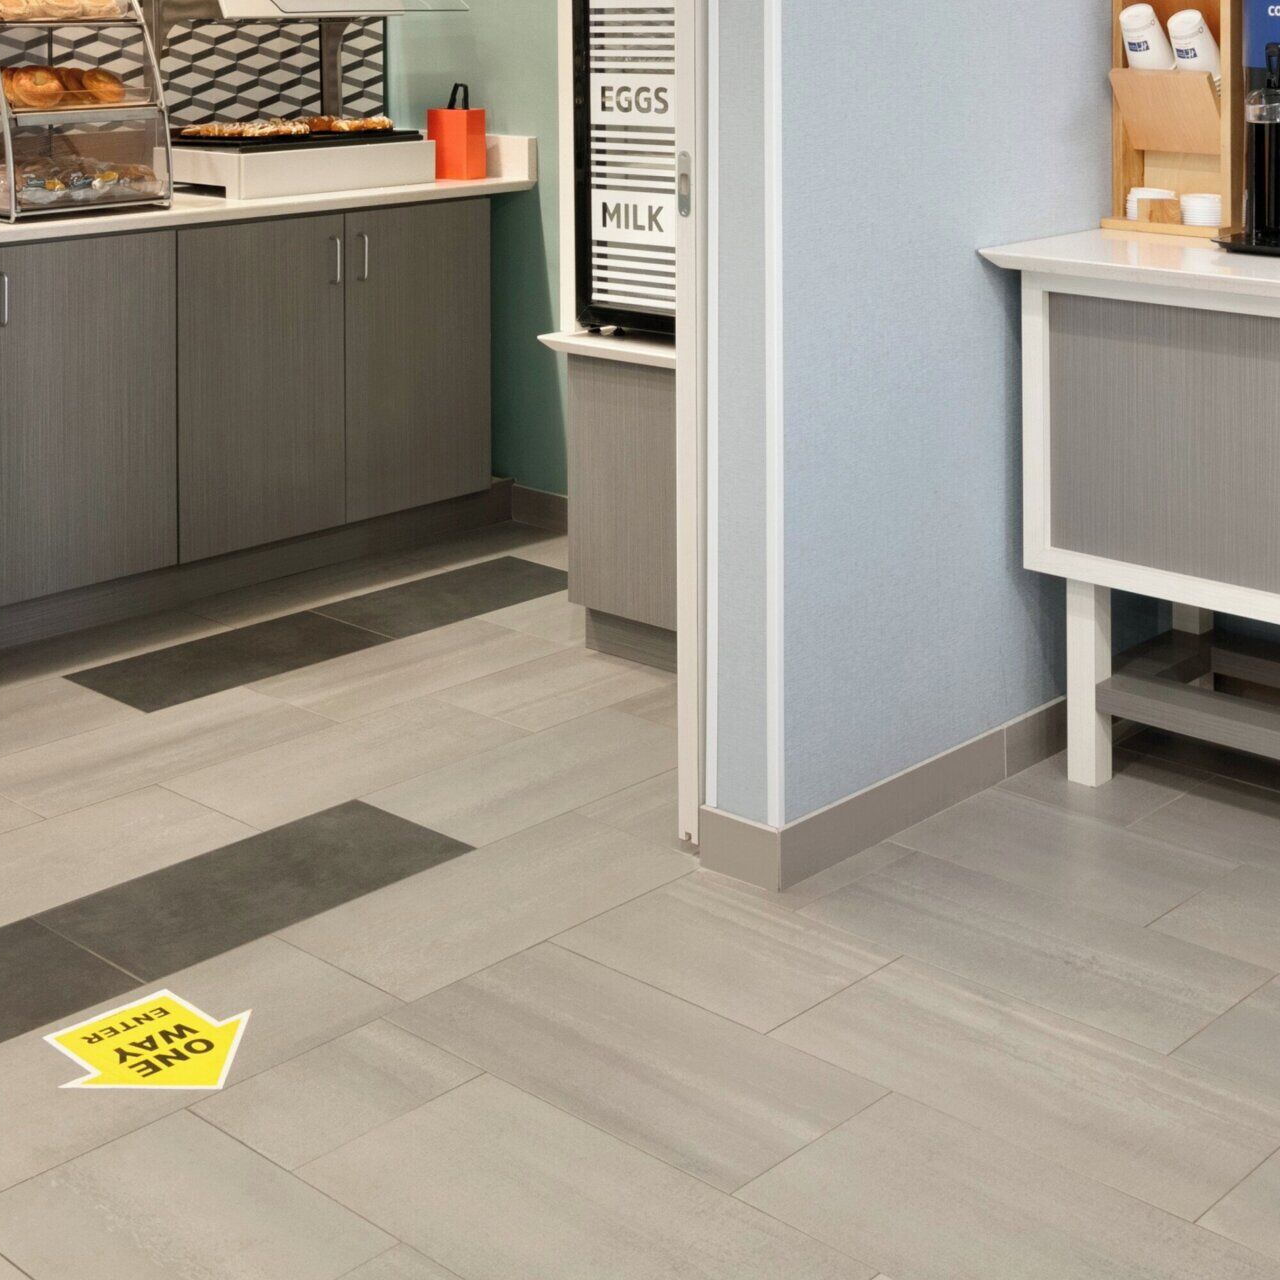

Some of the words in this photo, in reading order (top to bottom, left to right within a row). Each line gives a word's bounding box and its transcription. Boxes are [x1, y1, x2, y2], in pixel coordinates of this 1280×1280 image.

[600, 85, 669, 114] EGGS
[602, 201, 664, 232] MILK
[81, 1006, 170, 1044] ENTER
[114, 1023, 200, 1064] WAY
[128, 1038, 215, 1078] ONE
